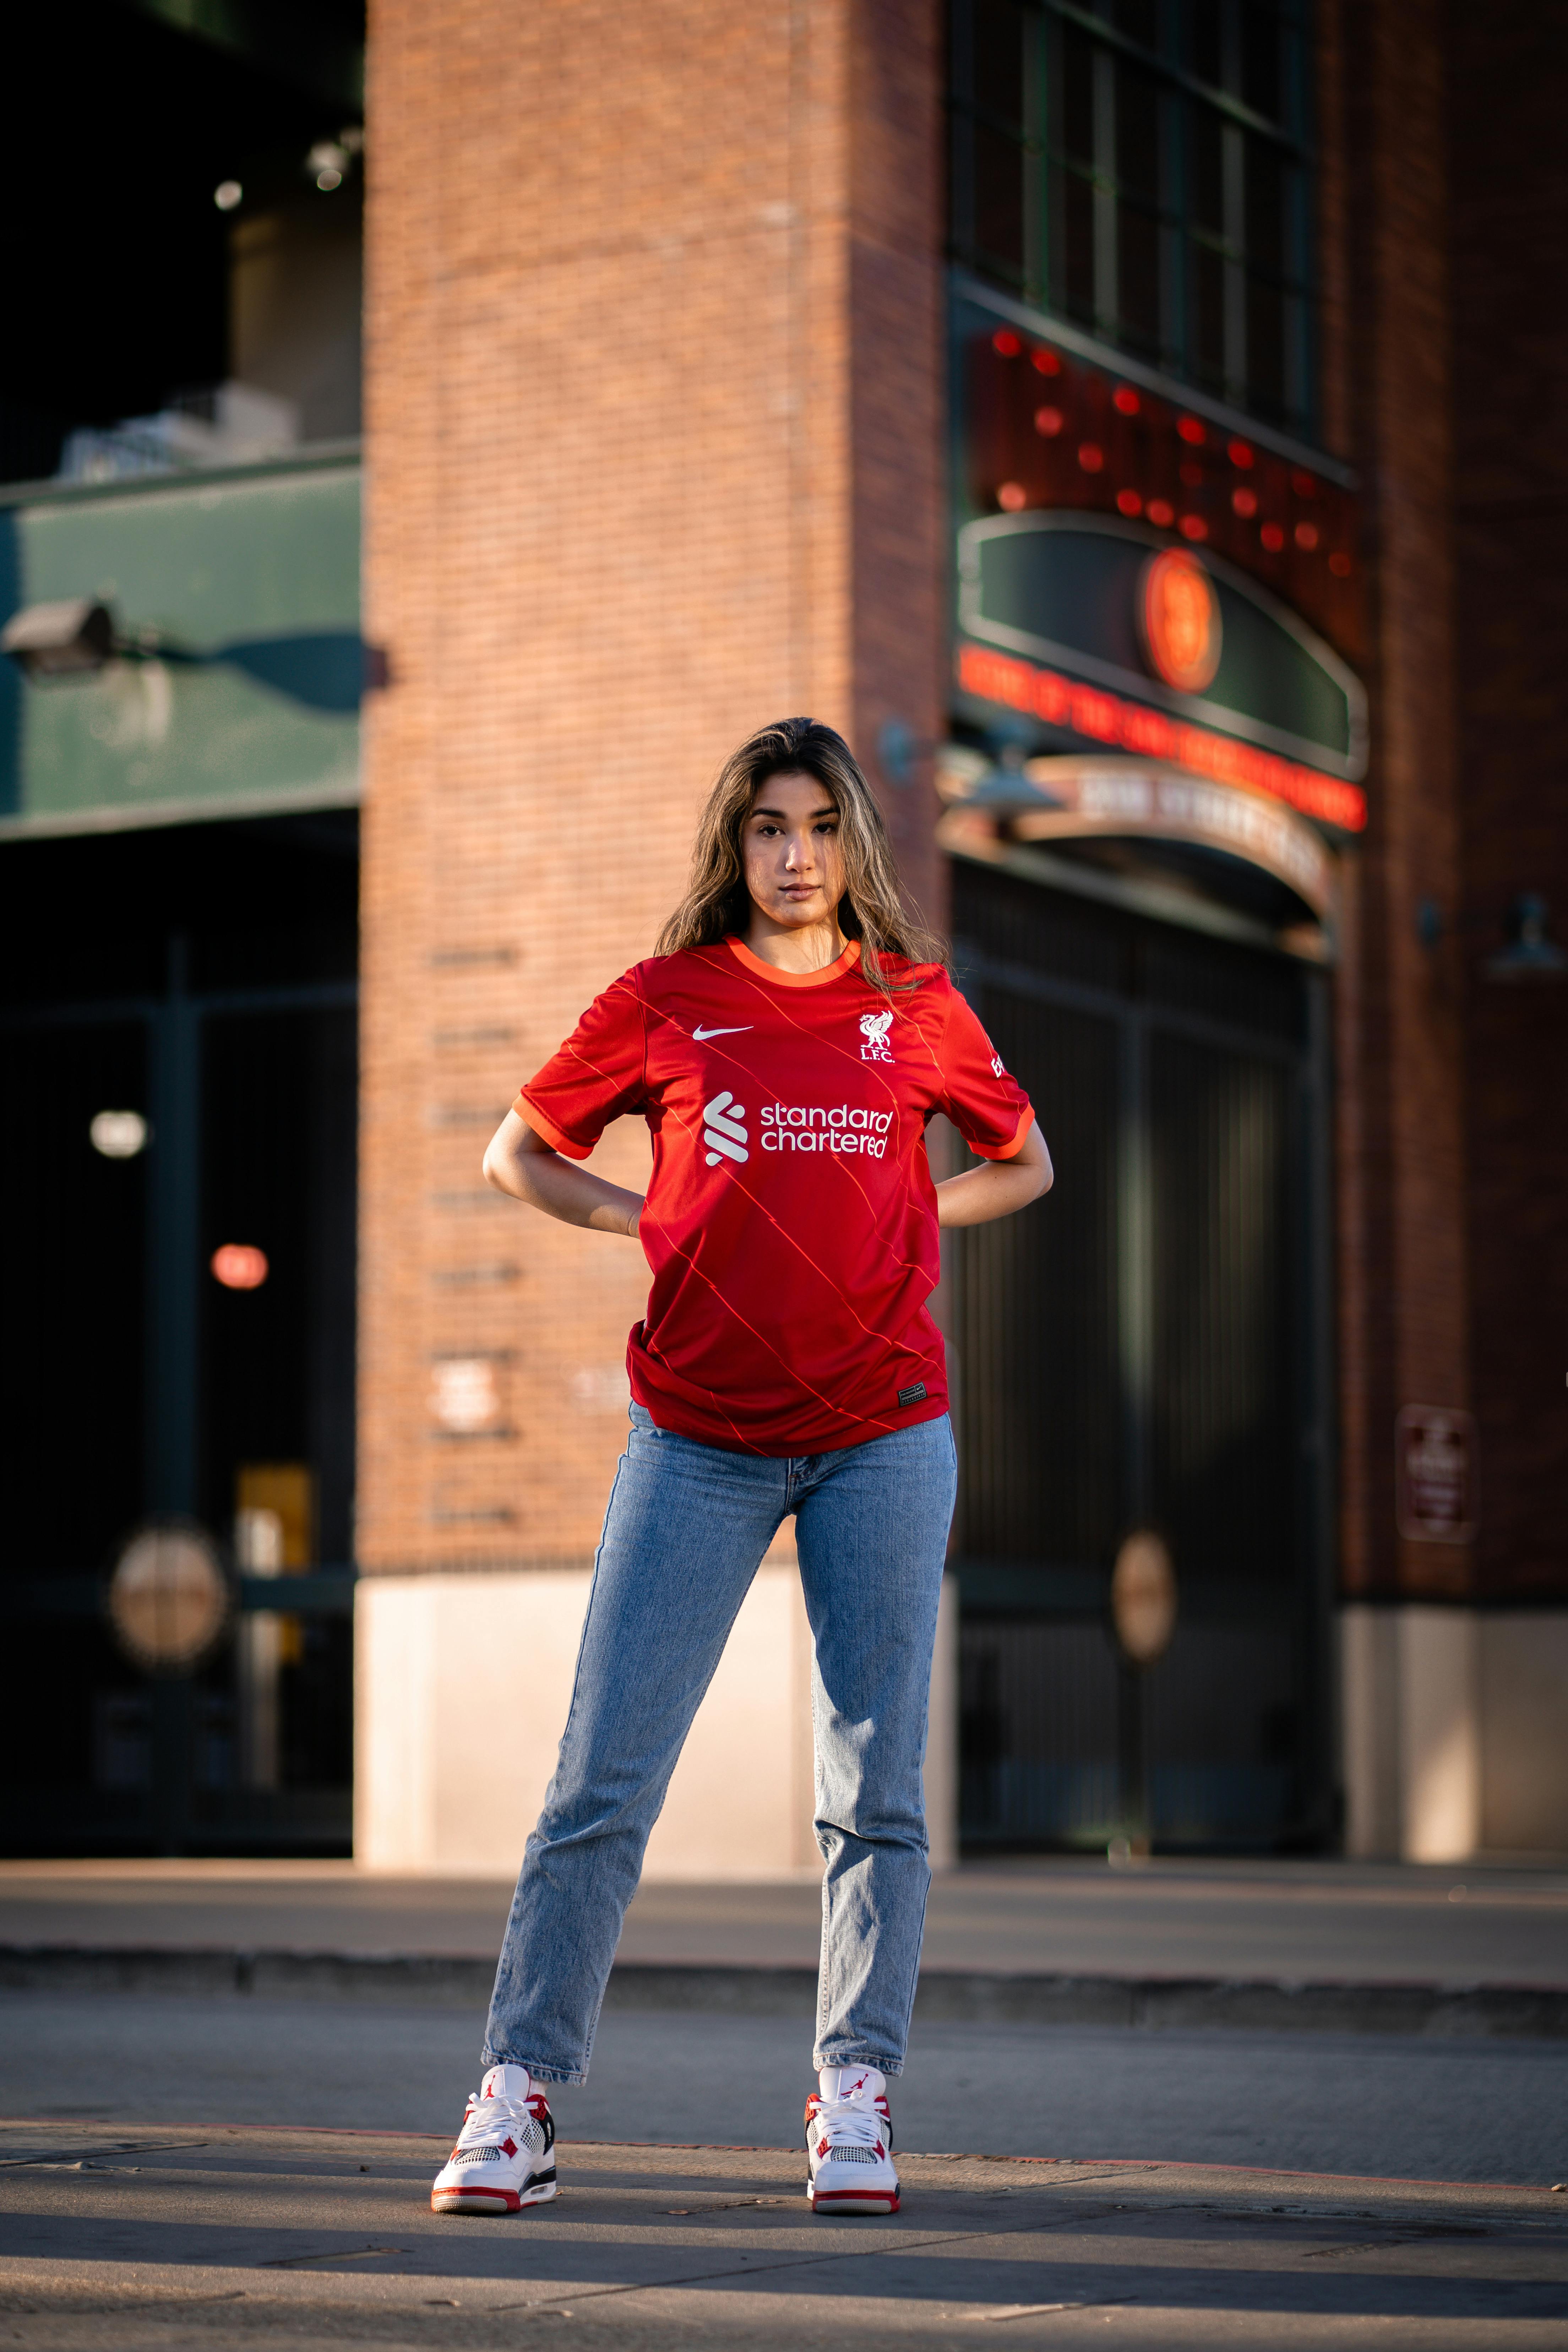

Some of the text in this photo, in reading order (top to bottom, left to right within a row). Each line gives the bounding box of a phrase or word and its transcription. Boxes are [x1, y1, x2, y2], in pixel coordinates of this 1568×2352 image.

[860, 1048, 895, 1063] L.F.C.
[761, 1102, 893, 1133] standard
[761, 1127, 888, 1159] chartered
